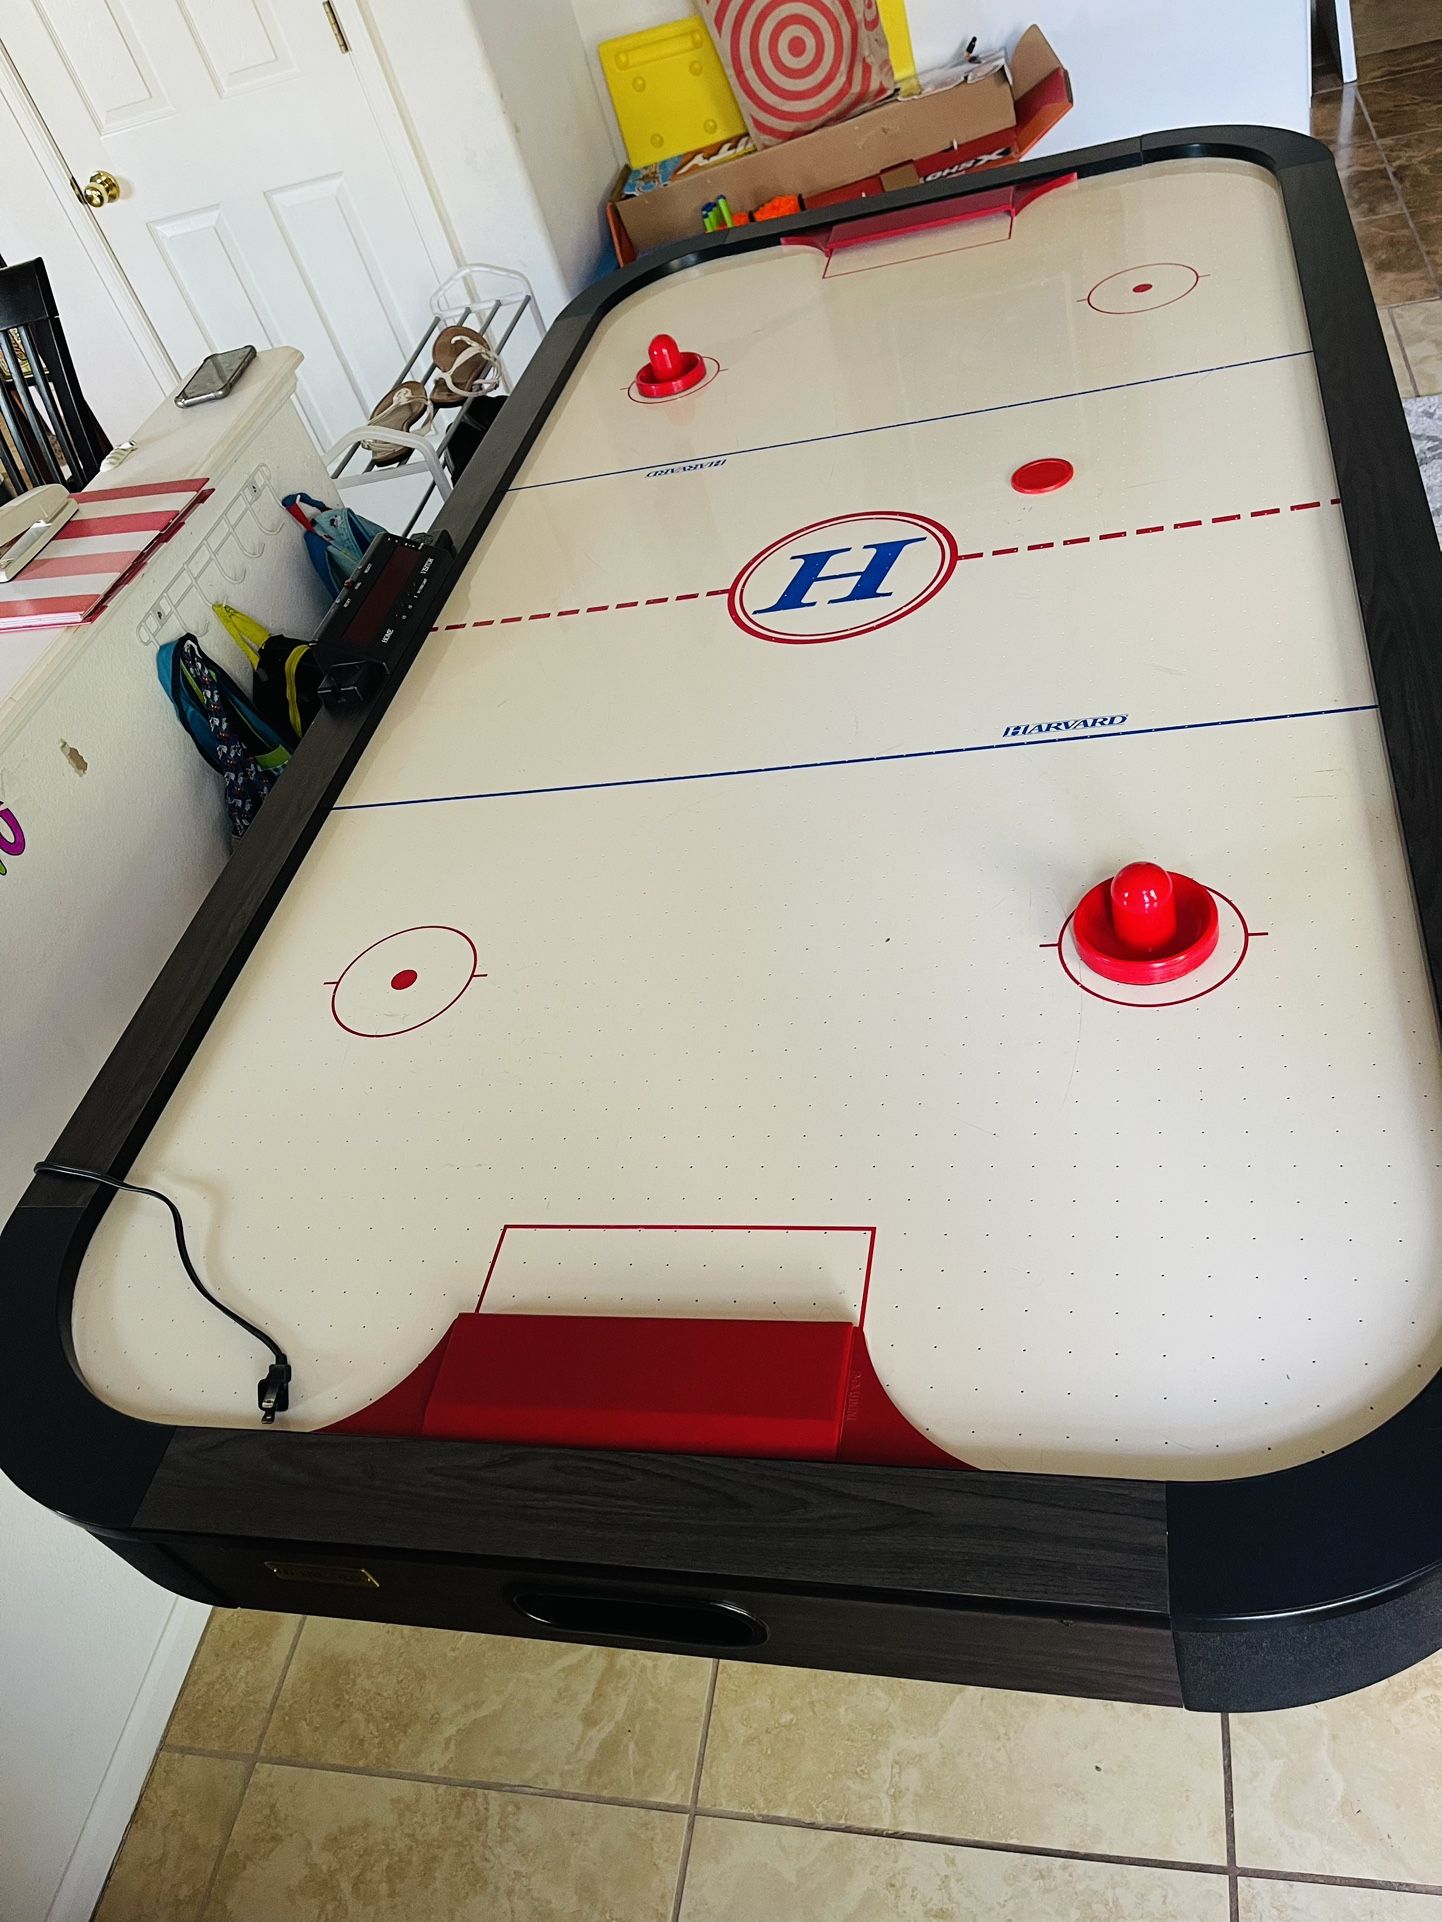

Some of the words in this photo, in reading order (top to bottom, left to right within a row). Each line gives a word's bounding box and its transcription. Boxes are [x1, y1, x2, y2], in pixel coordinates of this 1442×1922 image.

[919, 146, 1013, 184] XSHO
[644, 458, 727, 478] HARVARD
[751, 536, 927, 615] H
[1002, 713, 1129, 738] HARVARD
